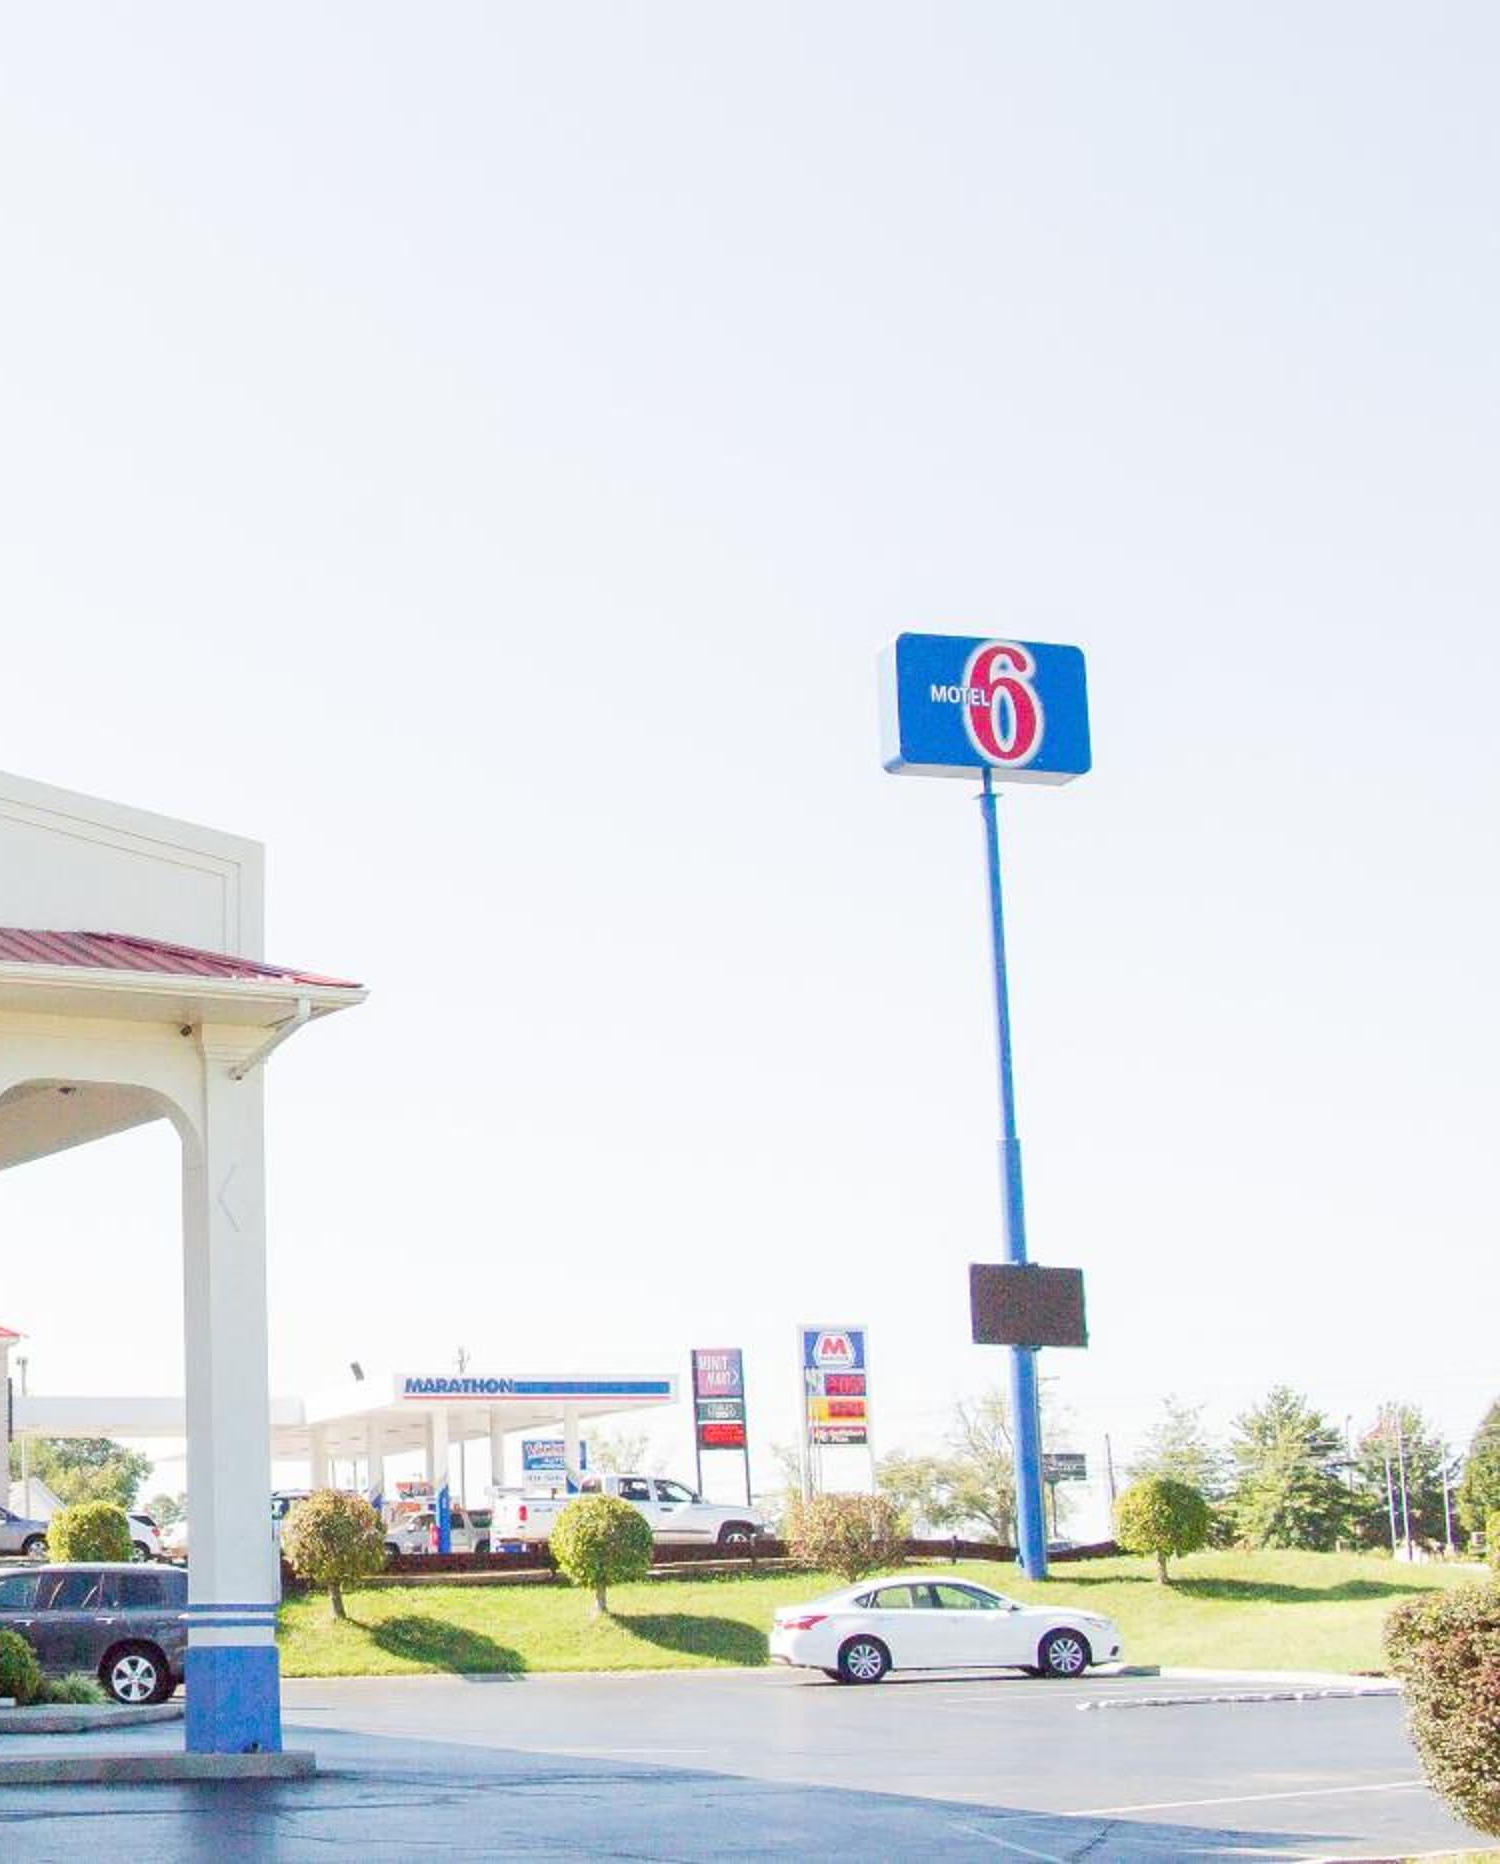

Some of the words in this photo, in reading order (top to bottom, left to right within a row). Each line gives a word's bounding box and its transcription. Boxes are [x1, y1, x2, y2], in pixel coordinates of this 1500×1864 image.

[930, 684, 991, 707] MOTEL
[969, 645, 1037, 760] 6
[405, 1378, 514, 1393] MARATHON
